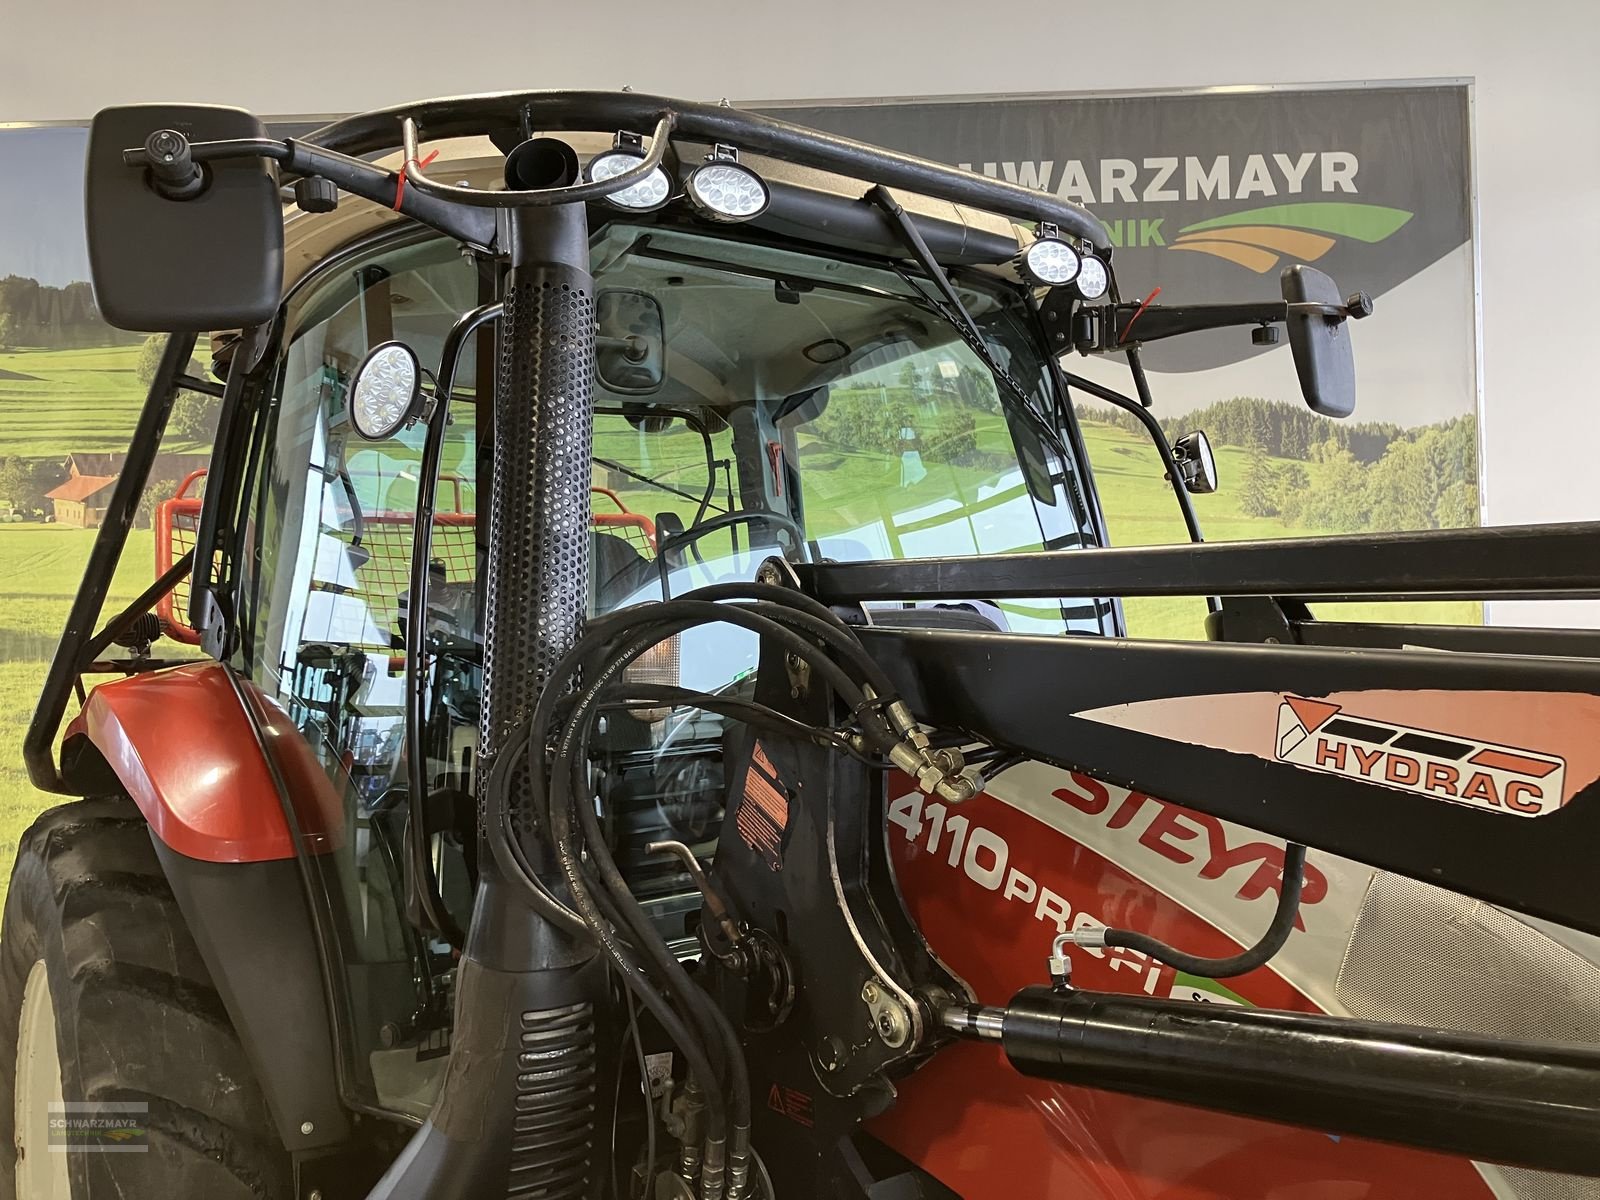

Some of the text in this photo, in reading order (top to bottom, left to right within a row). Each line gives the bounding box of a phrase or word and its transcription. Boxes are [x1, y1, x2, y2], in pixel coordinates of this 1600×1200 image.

[958, 151, 1359, 204] WARZMAYR
[1315, 737, 1545, 815] HYDRAC
[887, 791, 1009, 891] 4110
